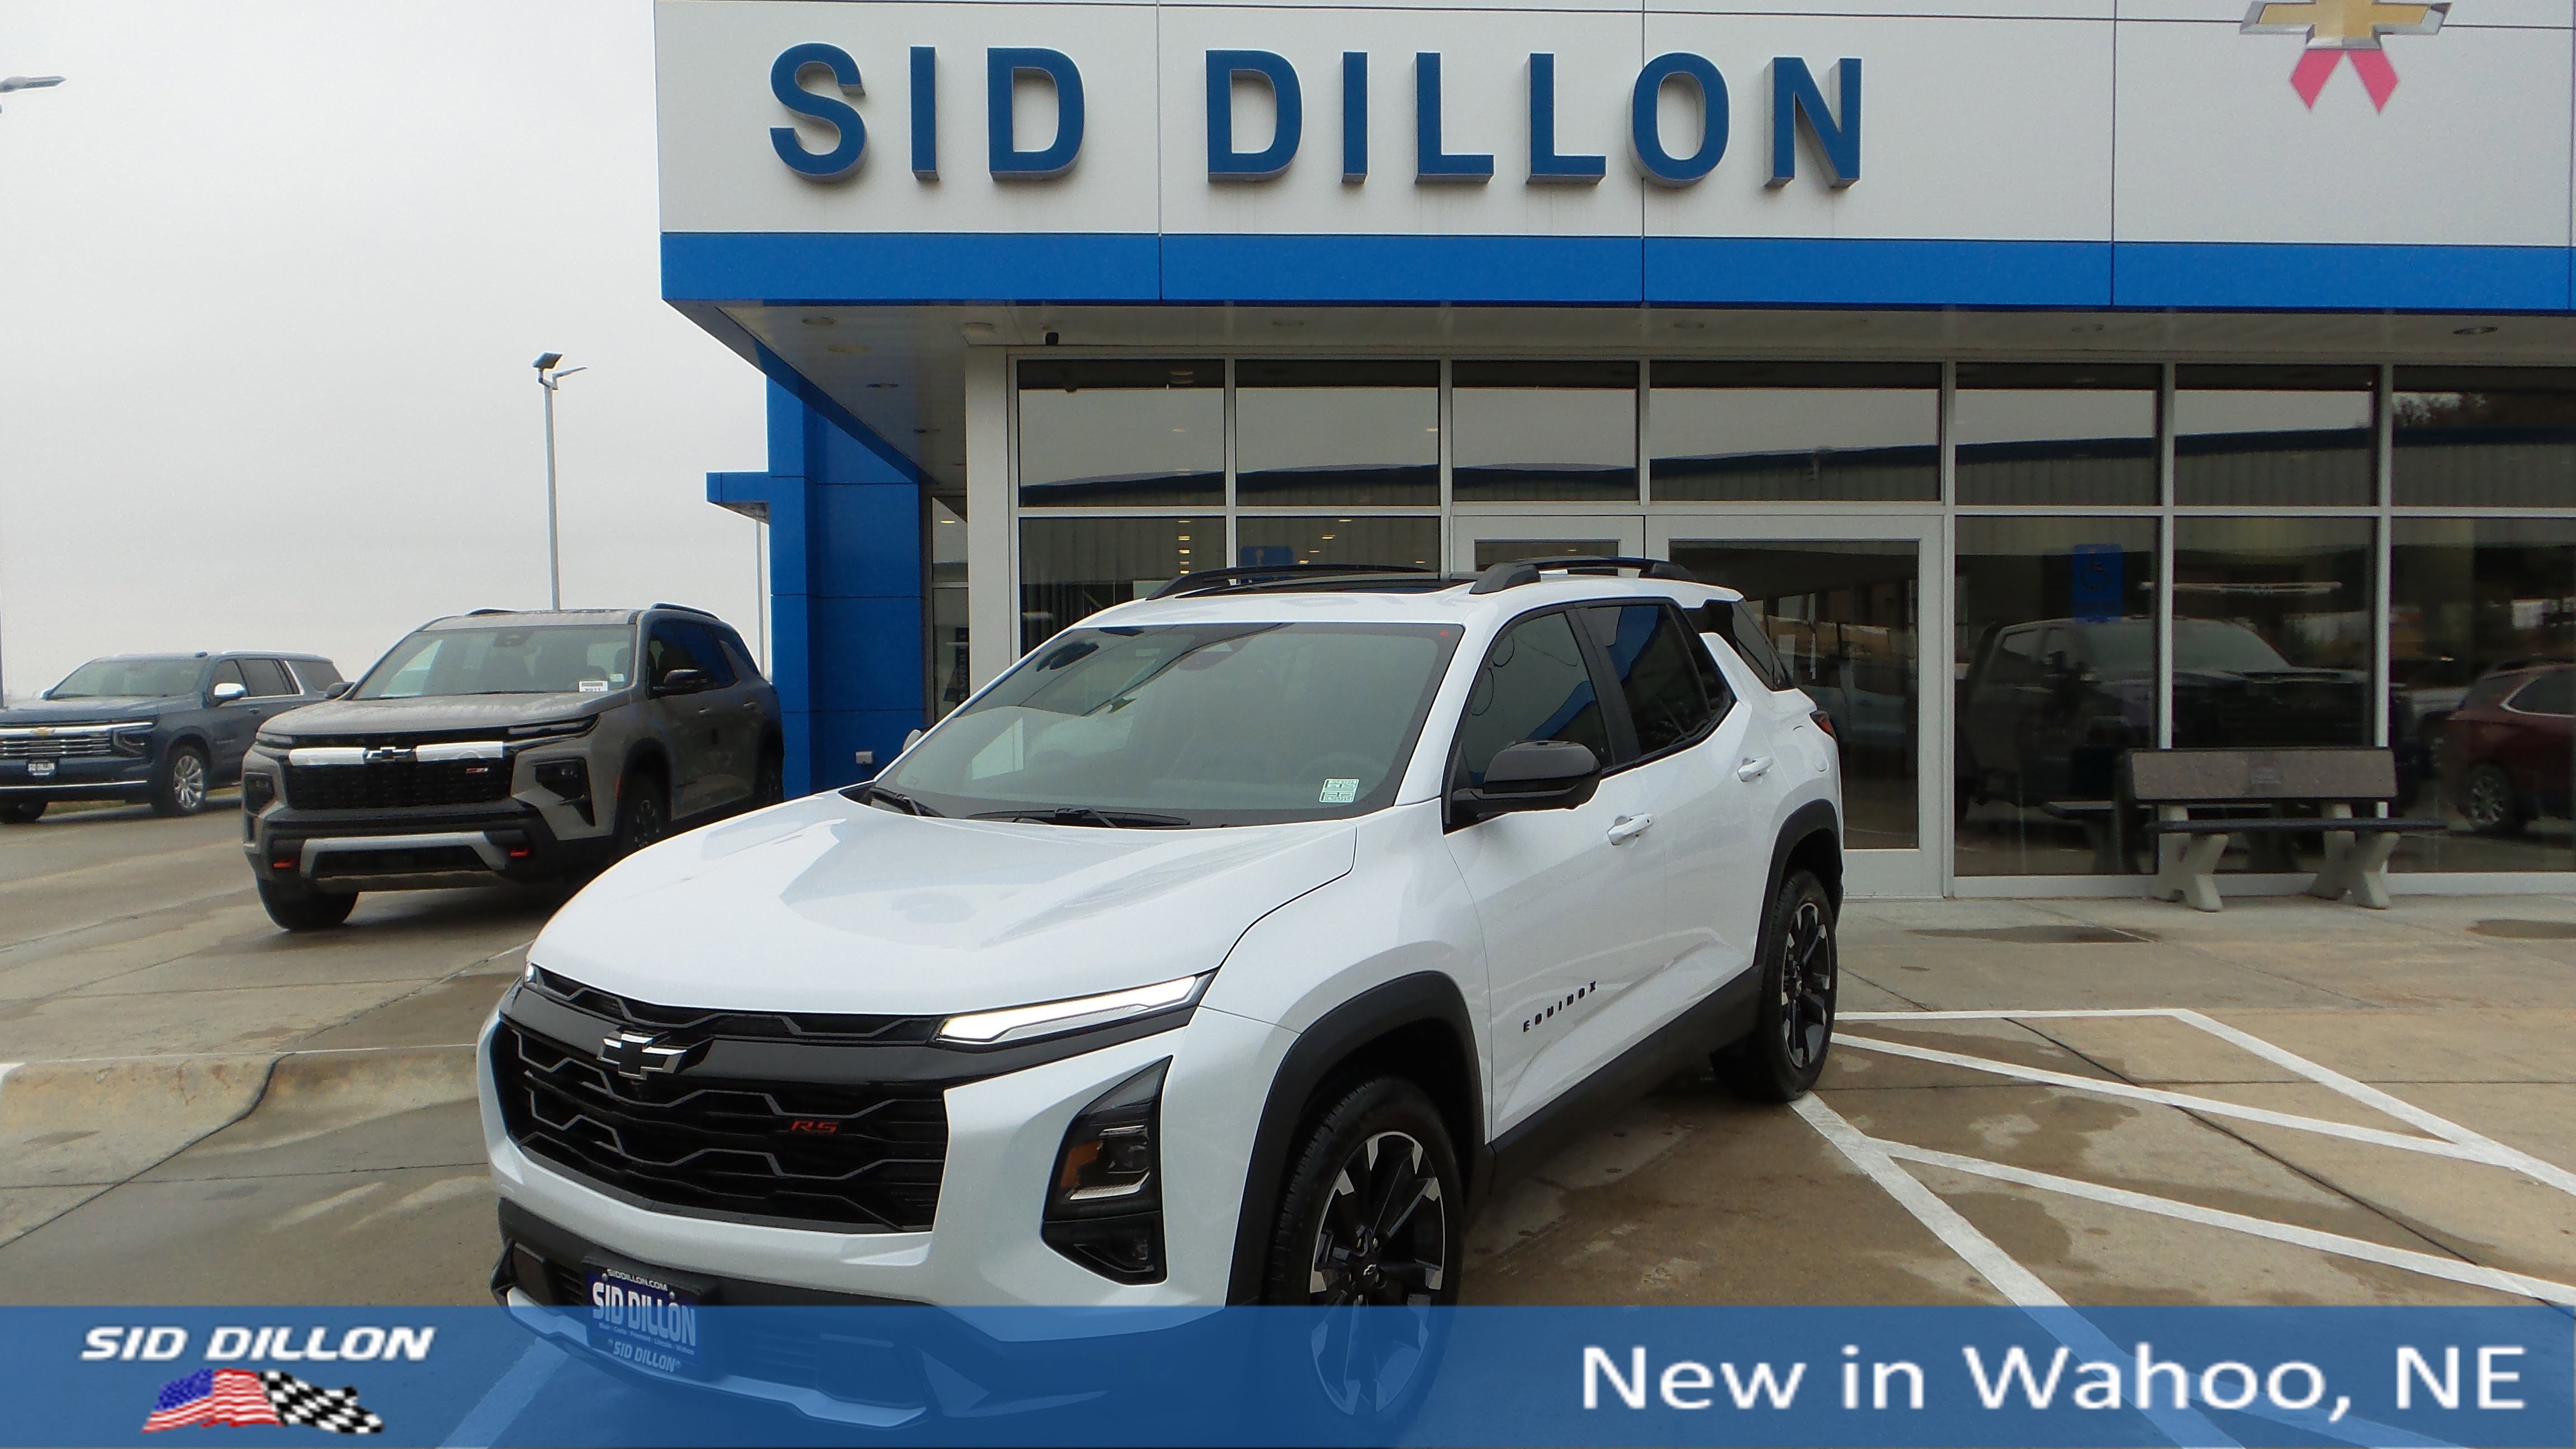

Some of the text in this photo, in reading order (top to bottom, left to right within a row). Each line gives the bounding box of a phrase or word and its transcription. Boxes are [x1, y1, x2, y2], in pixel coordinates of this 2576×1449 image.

[769, 42, 1862, 189] SID DILLON
[1523, 981, 1597, 1032] EQUINOX
[790, 1120, 839, 1133] RS
[593, 1282, 696, 1346] SID DILLON
[613, 1341, 676, 1372] SID DILLON
